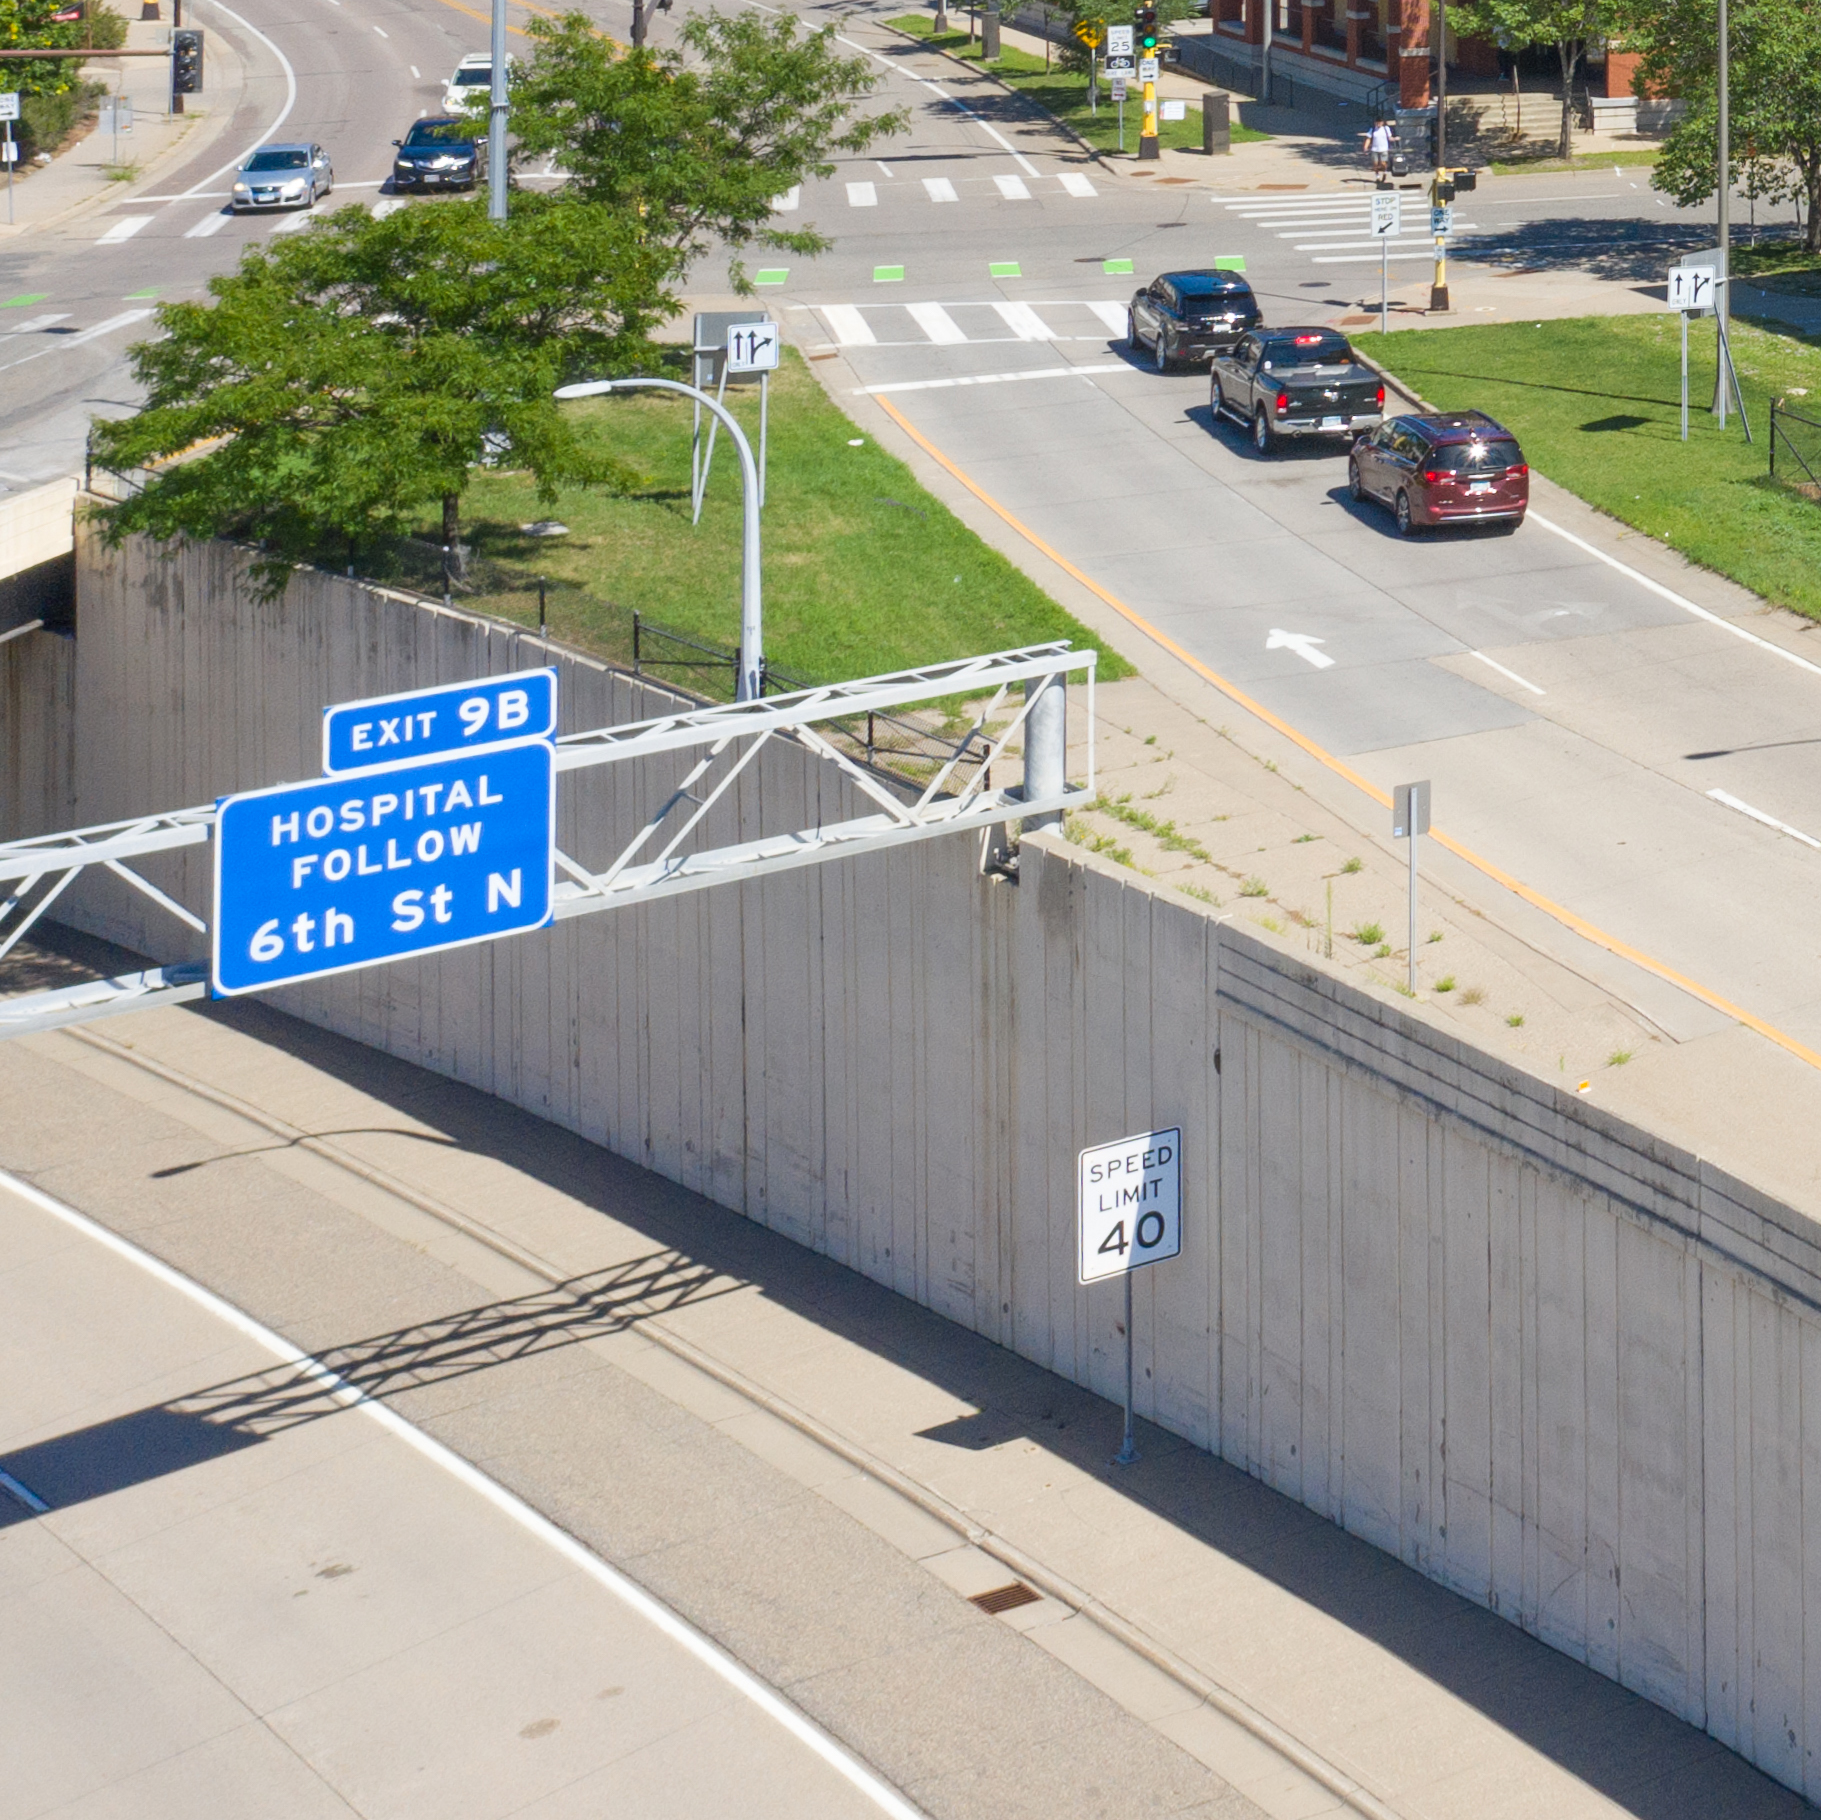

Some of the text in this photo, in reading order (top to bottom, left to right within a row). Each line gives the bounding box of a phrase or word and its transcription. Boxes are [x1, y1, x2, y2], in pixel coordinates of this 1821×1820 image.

[1110, 41, 1131, 52] 25
[1375, 196, 1396, 205] STOP
[1378, 213, 1394, 221] RED
[351, 689, 531, 752] EXIT 9B
[271, 775, 503, 847] HOSPITAL
[292, 821, 484, 890] FOLLOW
[248, 869, 522, 963] 6th St N
[1089, 1145, 1173, 1183] SPEED
[1099, 1178, 1163, 1213] LIMIT
[1097, 1210, 1166, 1256] 40
